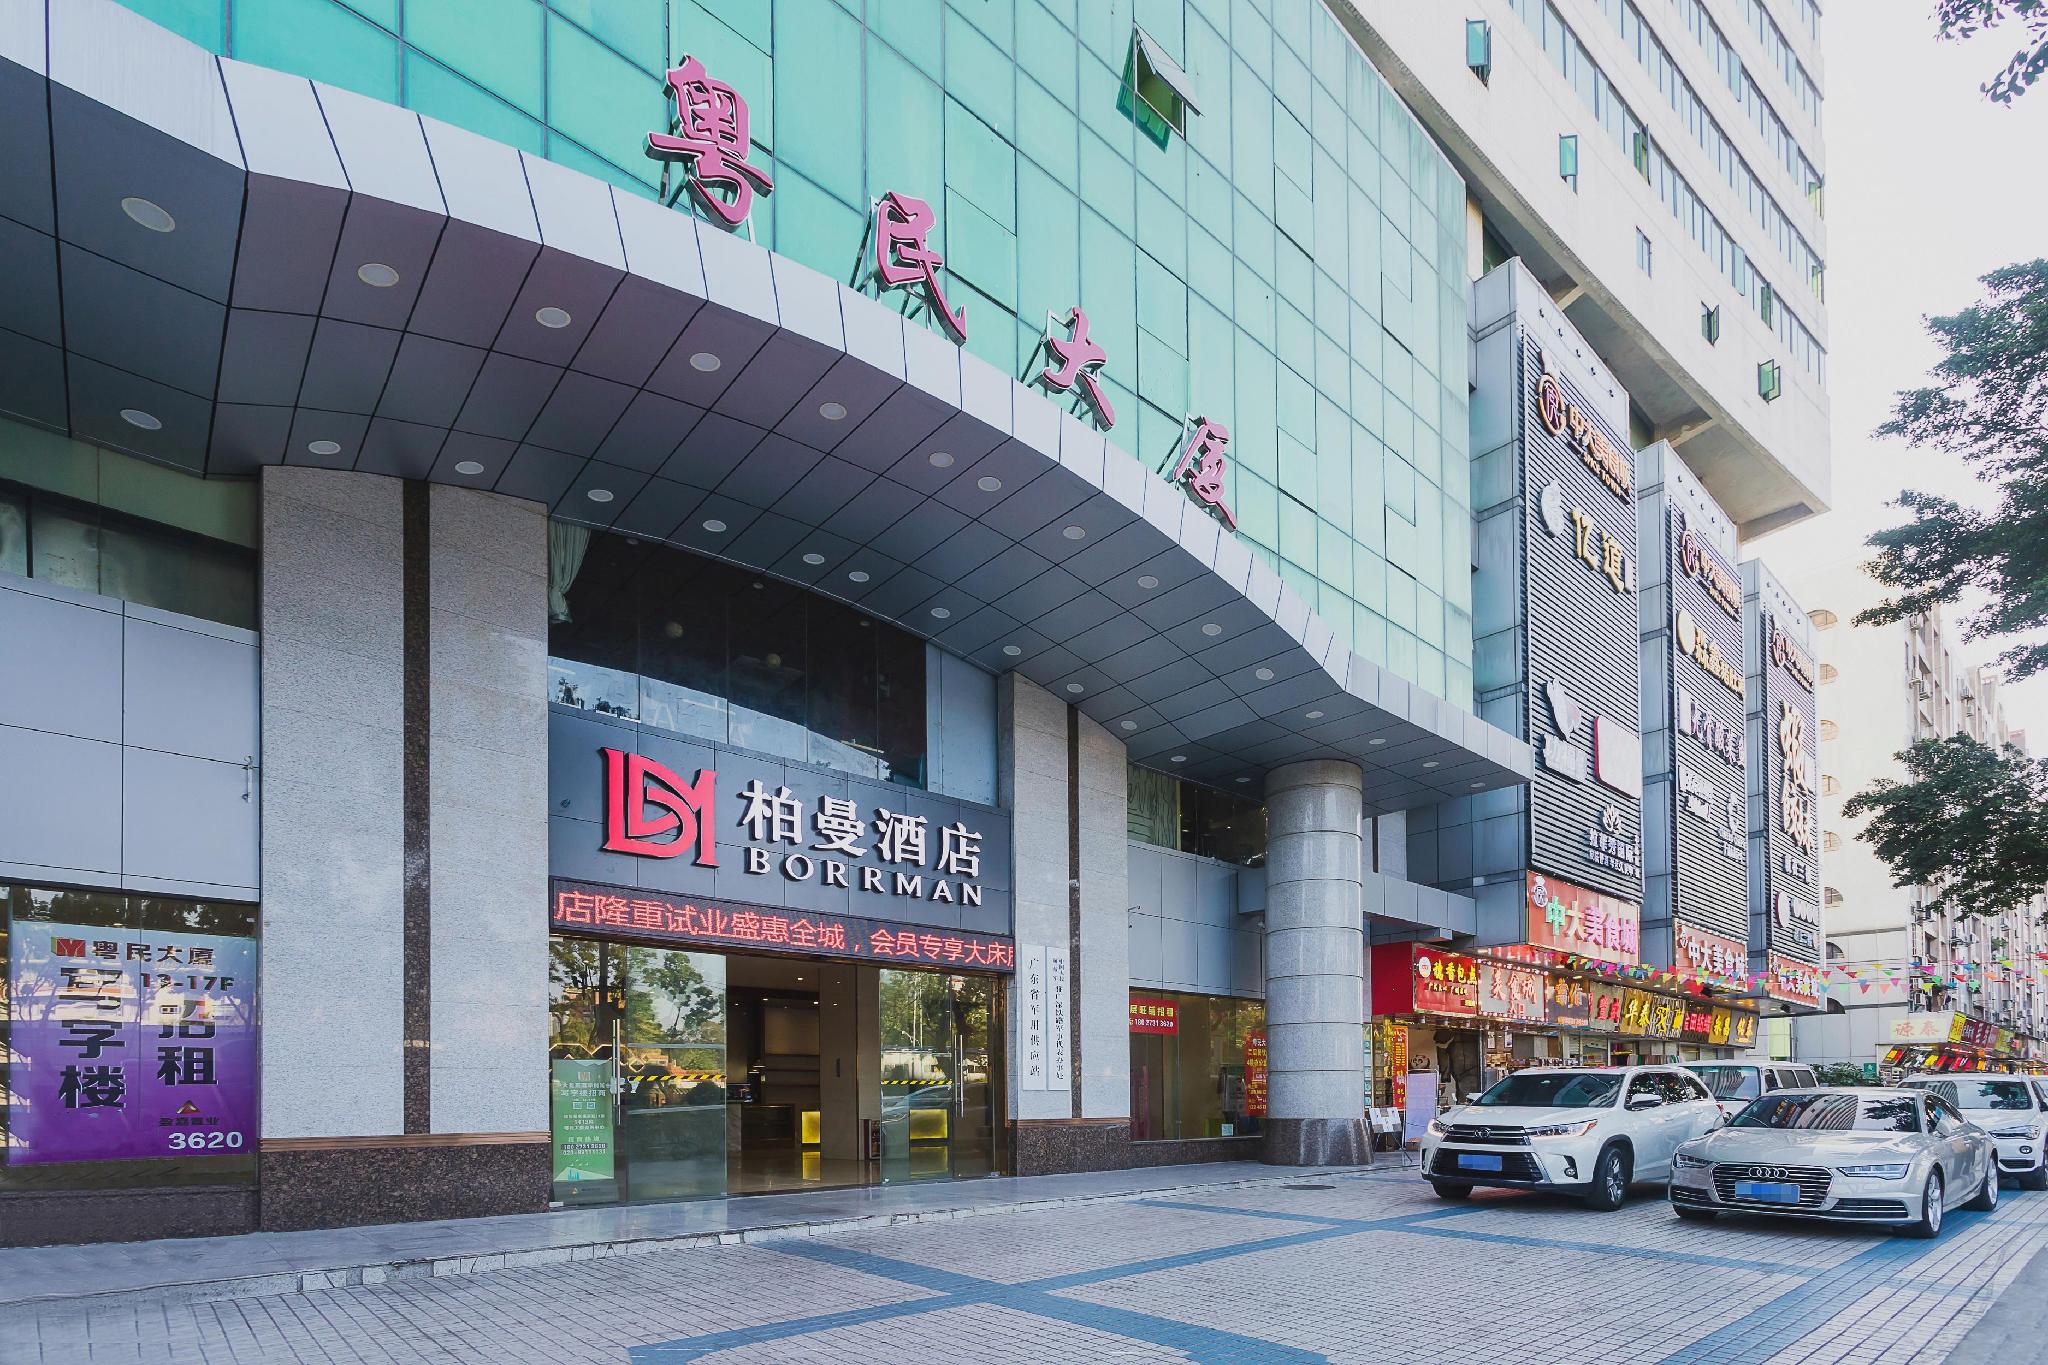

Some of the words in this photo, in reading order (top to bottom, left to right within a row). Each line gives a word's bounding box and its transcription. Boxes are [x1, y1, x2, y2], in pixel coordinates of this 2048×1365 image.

[644, 53, 1238, 532] 粤民大厦
[741, 779, 983, 878] 柏曼酒店
[749, 847, 983, 906] BORRMAN
[93, 941, 214, 966] 粤民大厦
[1546, 896, 1636, 955] 中大美食城
[168, 1131, 243, 1150] 3620
